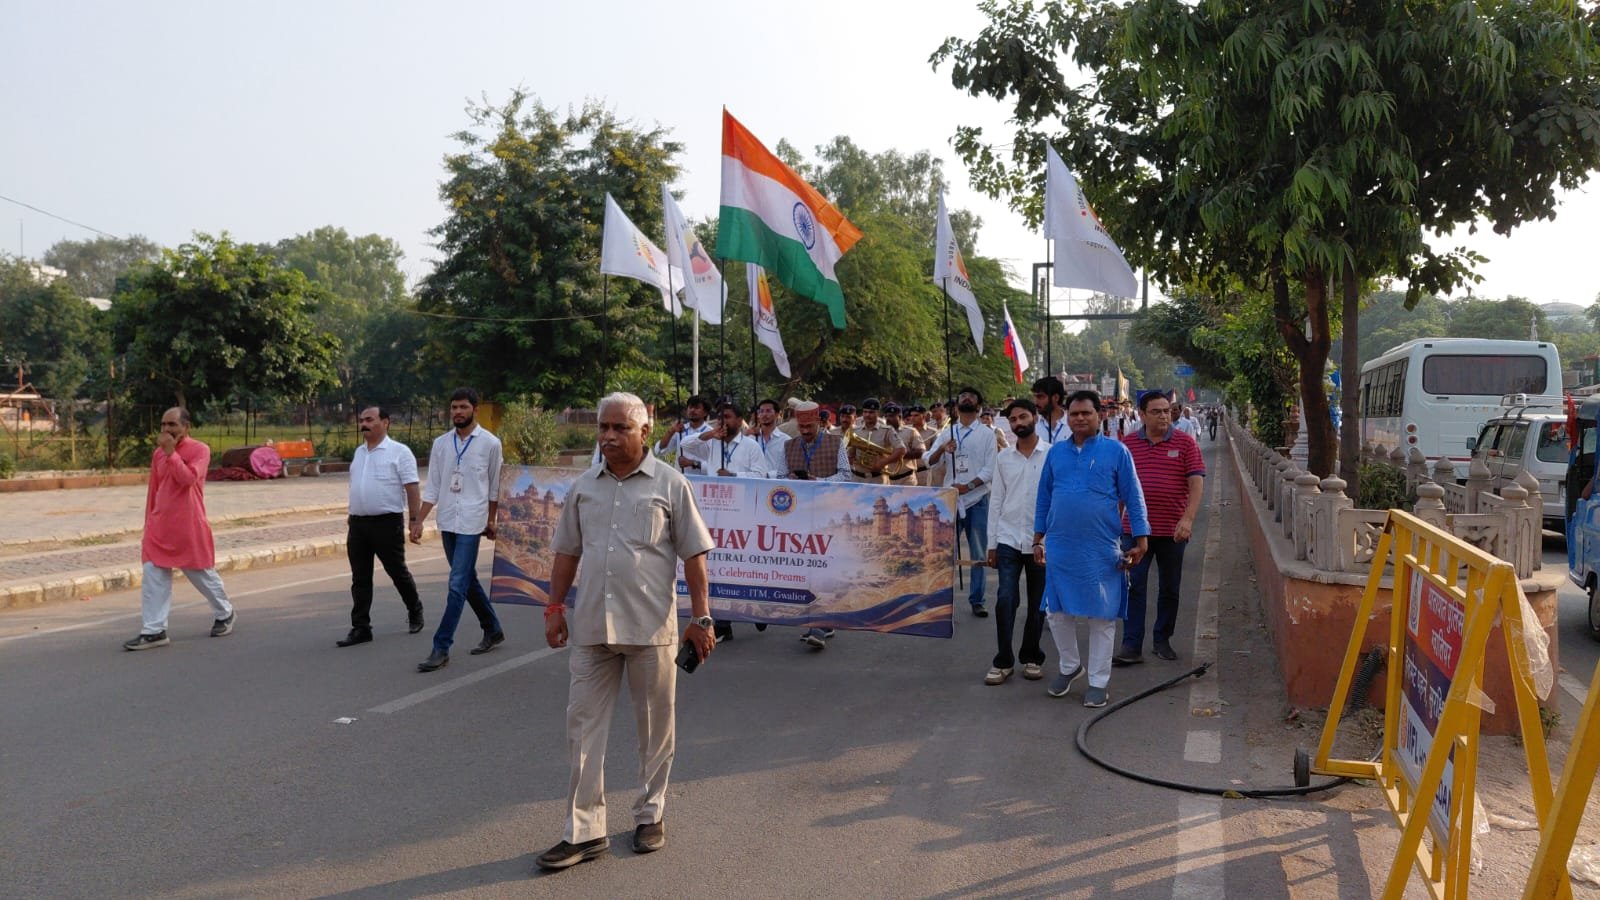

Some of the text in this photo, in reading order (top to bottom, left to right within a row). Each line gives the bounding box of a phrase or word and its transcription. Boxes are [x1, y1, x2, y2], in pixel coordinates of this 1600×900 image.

[703, 484, 735, 499] ITM
[708, 524, 833, 555] HAV UTSAV
[706, 551, 828, 569] LTURAL OLYMPIAD 2026
[719, 566, 768, 582] Celebrating
[771, 570, 806, 583] Dreams
[716, 586, 740, 596] Venue
[773, 590, 807, 601] Gwalior
